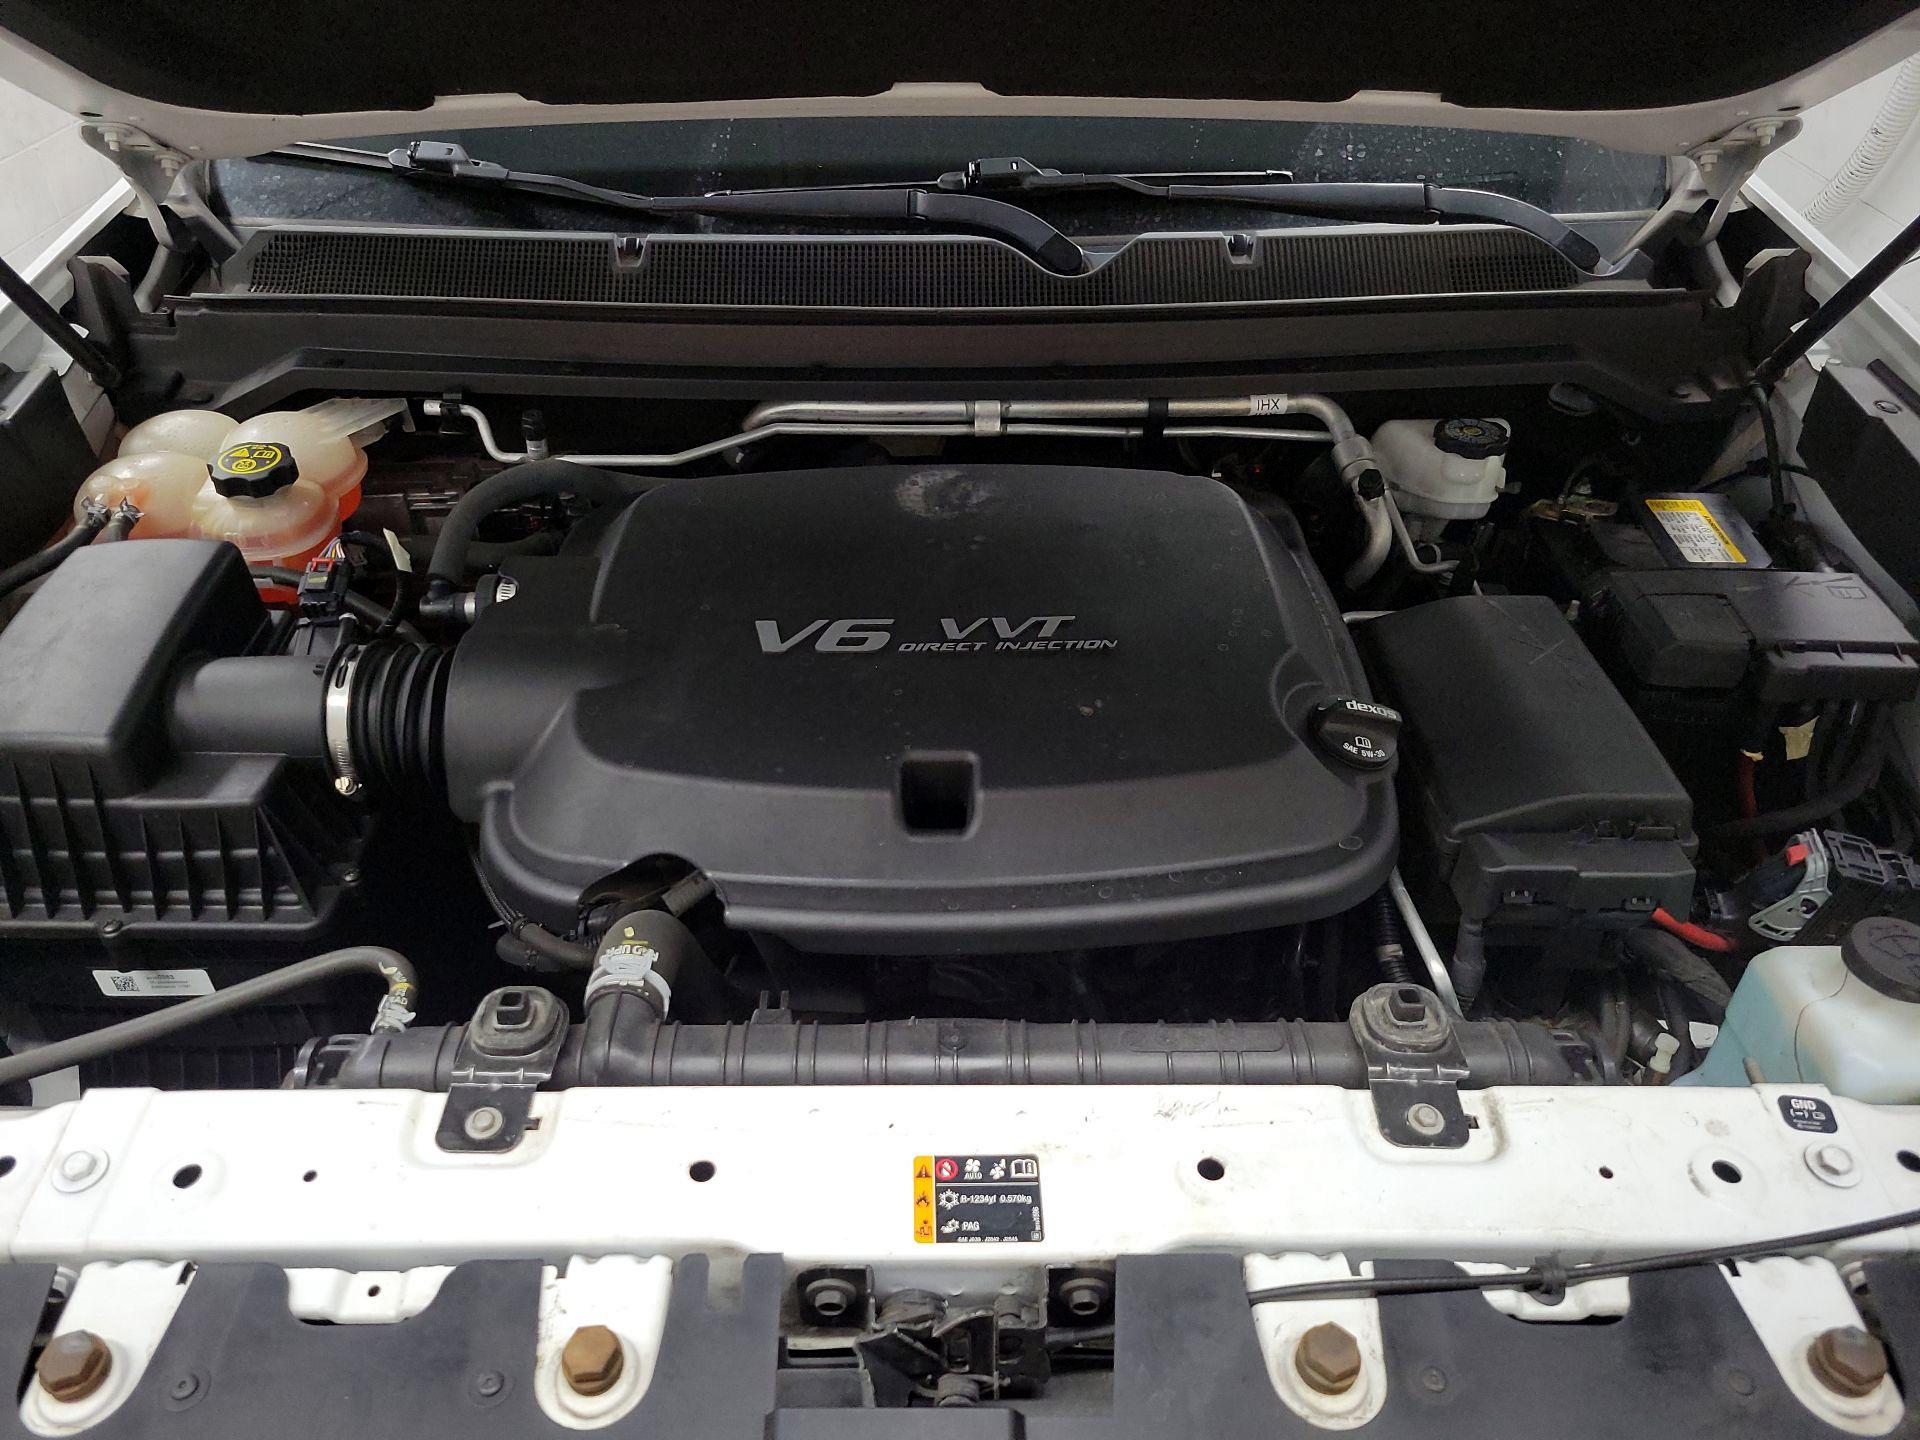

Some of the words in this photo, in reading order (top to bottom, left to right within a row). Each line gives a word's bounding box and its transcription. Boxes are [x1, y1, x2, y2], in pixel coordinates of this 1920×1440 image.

[1256, 398, 1280, 411] IHX
[940, 615, 1077, 640] VVT
[755, 618, 896, 653] V6
[898, 641, 988, 653] DIRECT
[994, 639, 1119, 651] INJECTION
[1345, 699, 1398, 720] dexos
[1342, 742, 1360, 755] SAE
[1360, 749, 1386, 759] 5W-30
[1790, 1098, 1817, 1111] GND
[963, 1172, 983, 1180] AUTO
[961, 1220, 981, 1232] PAG
